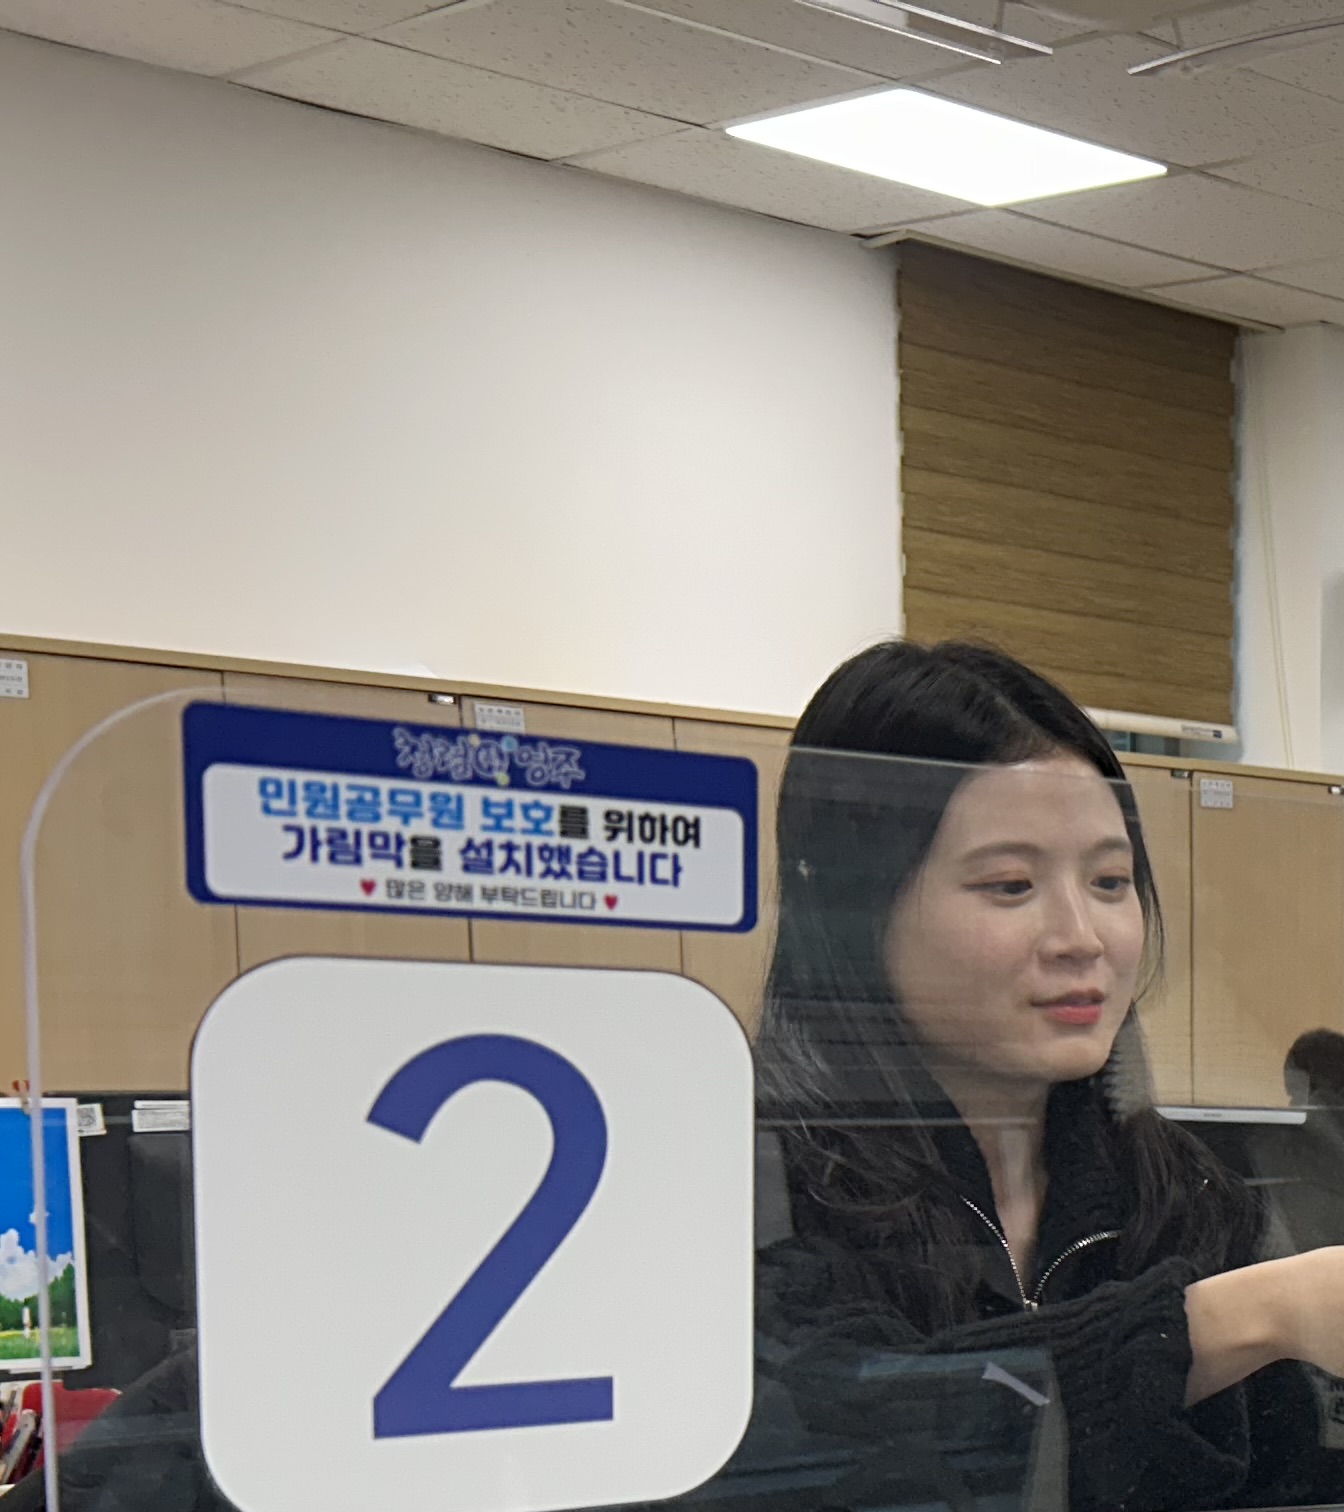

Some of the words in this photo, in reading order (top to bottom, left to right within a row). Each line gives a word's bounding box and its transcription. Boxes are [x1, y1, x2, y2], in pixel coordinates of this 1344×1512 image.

[258, 777, 465, 831] 민원공무원
[480, 794, 590, 840] 보호를
[603, 810, 701, 849] 위하여
[281, 824, 443, 872] 가림막을
[458, 836, 684, 888] 설치했습니다
[385, 879, 426, 901] 많은
[432, 881, 474, 905] 양해
[480, 883, 597, 911] 부탁드립니다
[366, 1033, 613, 1440] 2
